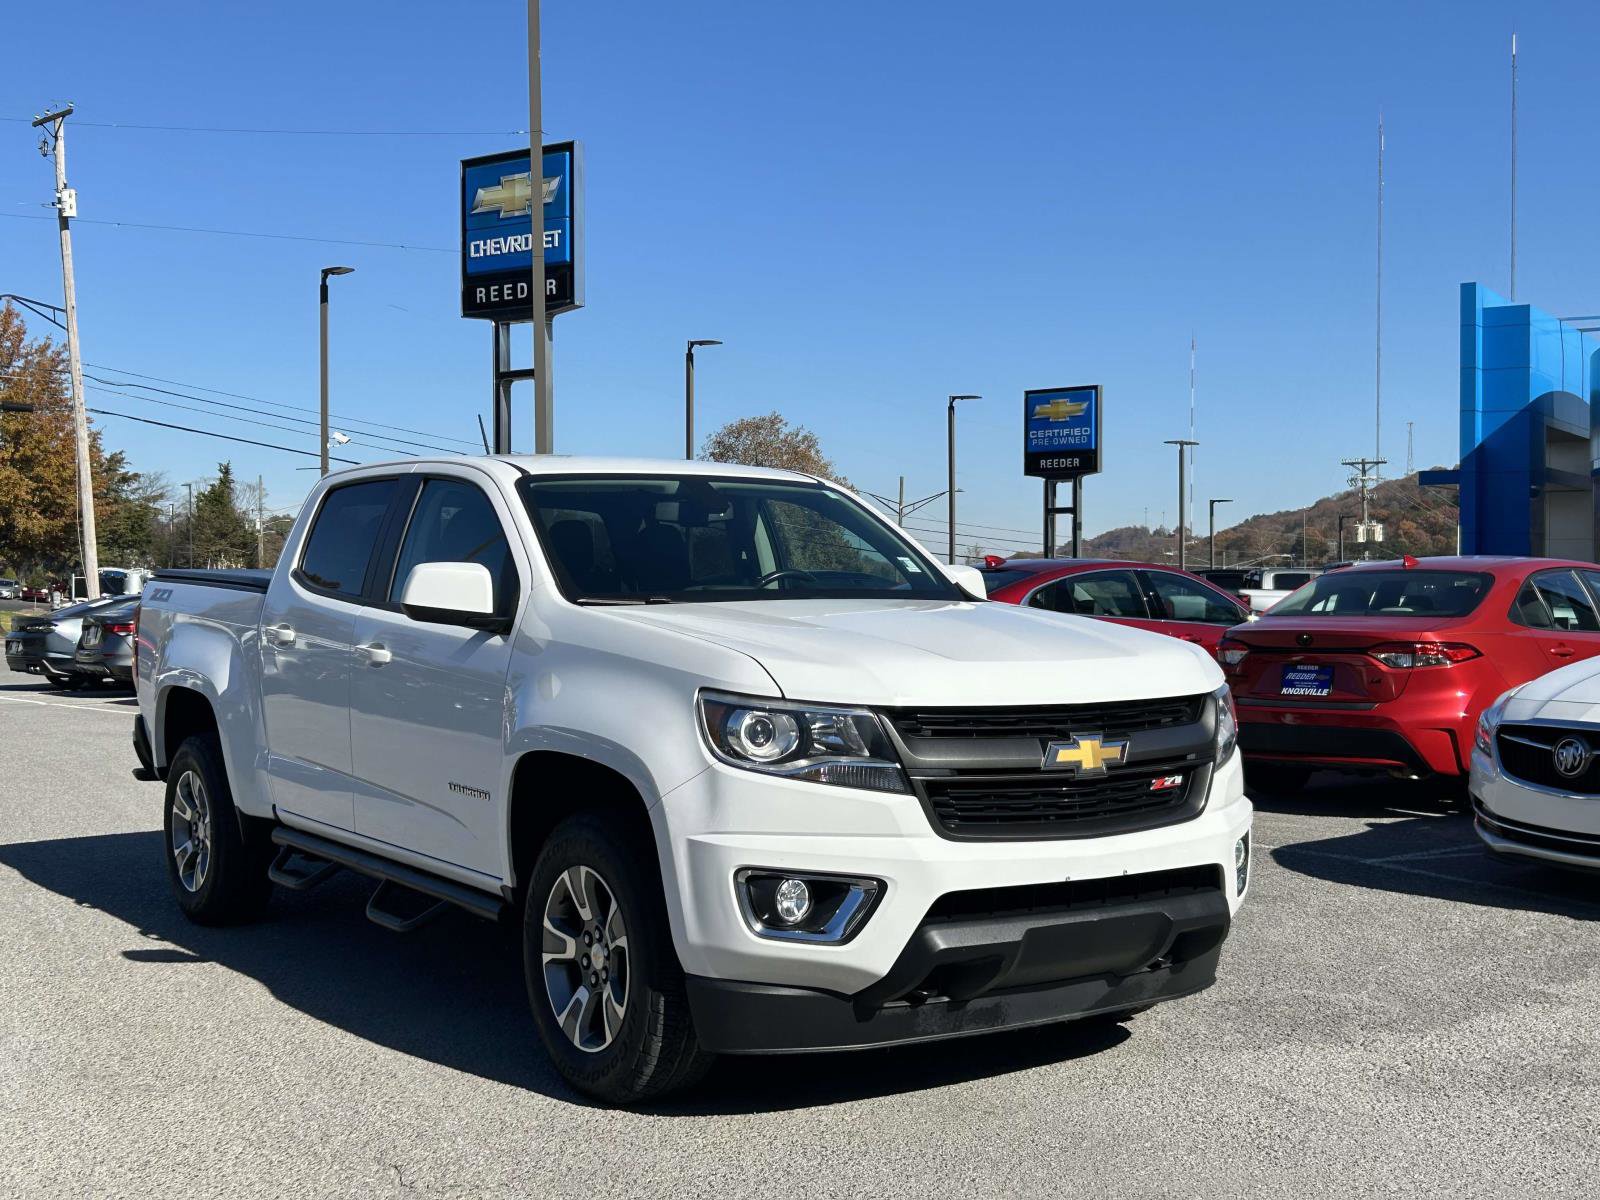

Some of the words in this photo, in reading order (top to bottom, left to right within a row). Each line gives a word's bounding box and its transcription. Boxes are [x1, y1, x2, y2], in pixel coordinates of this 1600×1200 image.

[470, 229, 562, 258] CHEVROET
[476, 279, 557, 303] REEDR
[1029, 427, 1090, 438] CERTIFIED
[1040, 458, 1080, 469] REEDER
[1286, 672, 1317, 680] REEDER
[1281, 687, 1330, 696] KNOXVILLE
